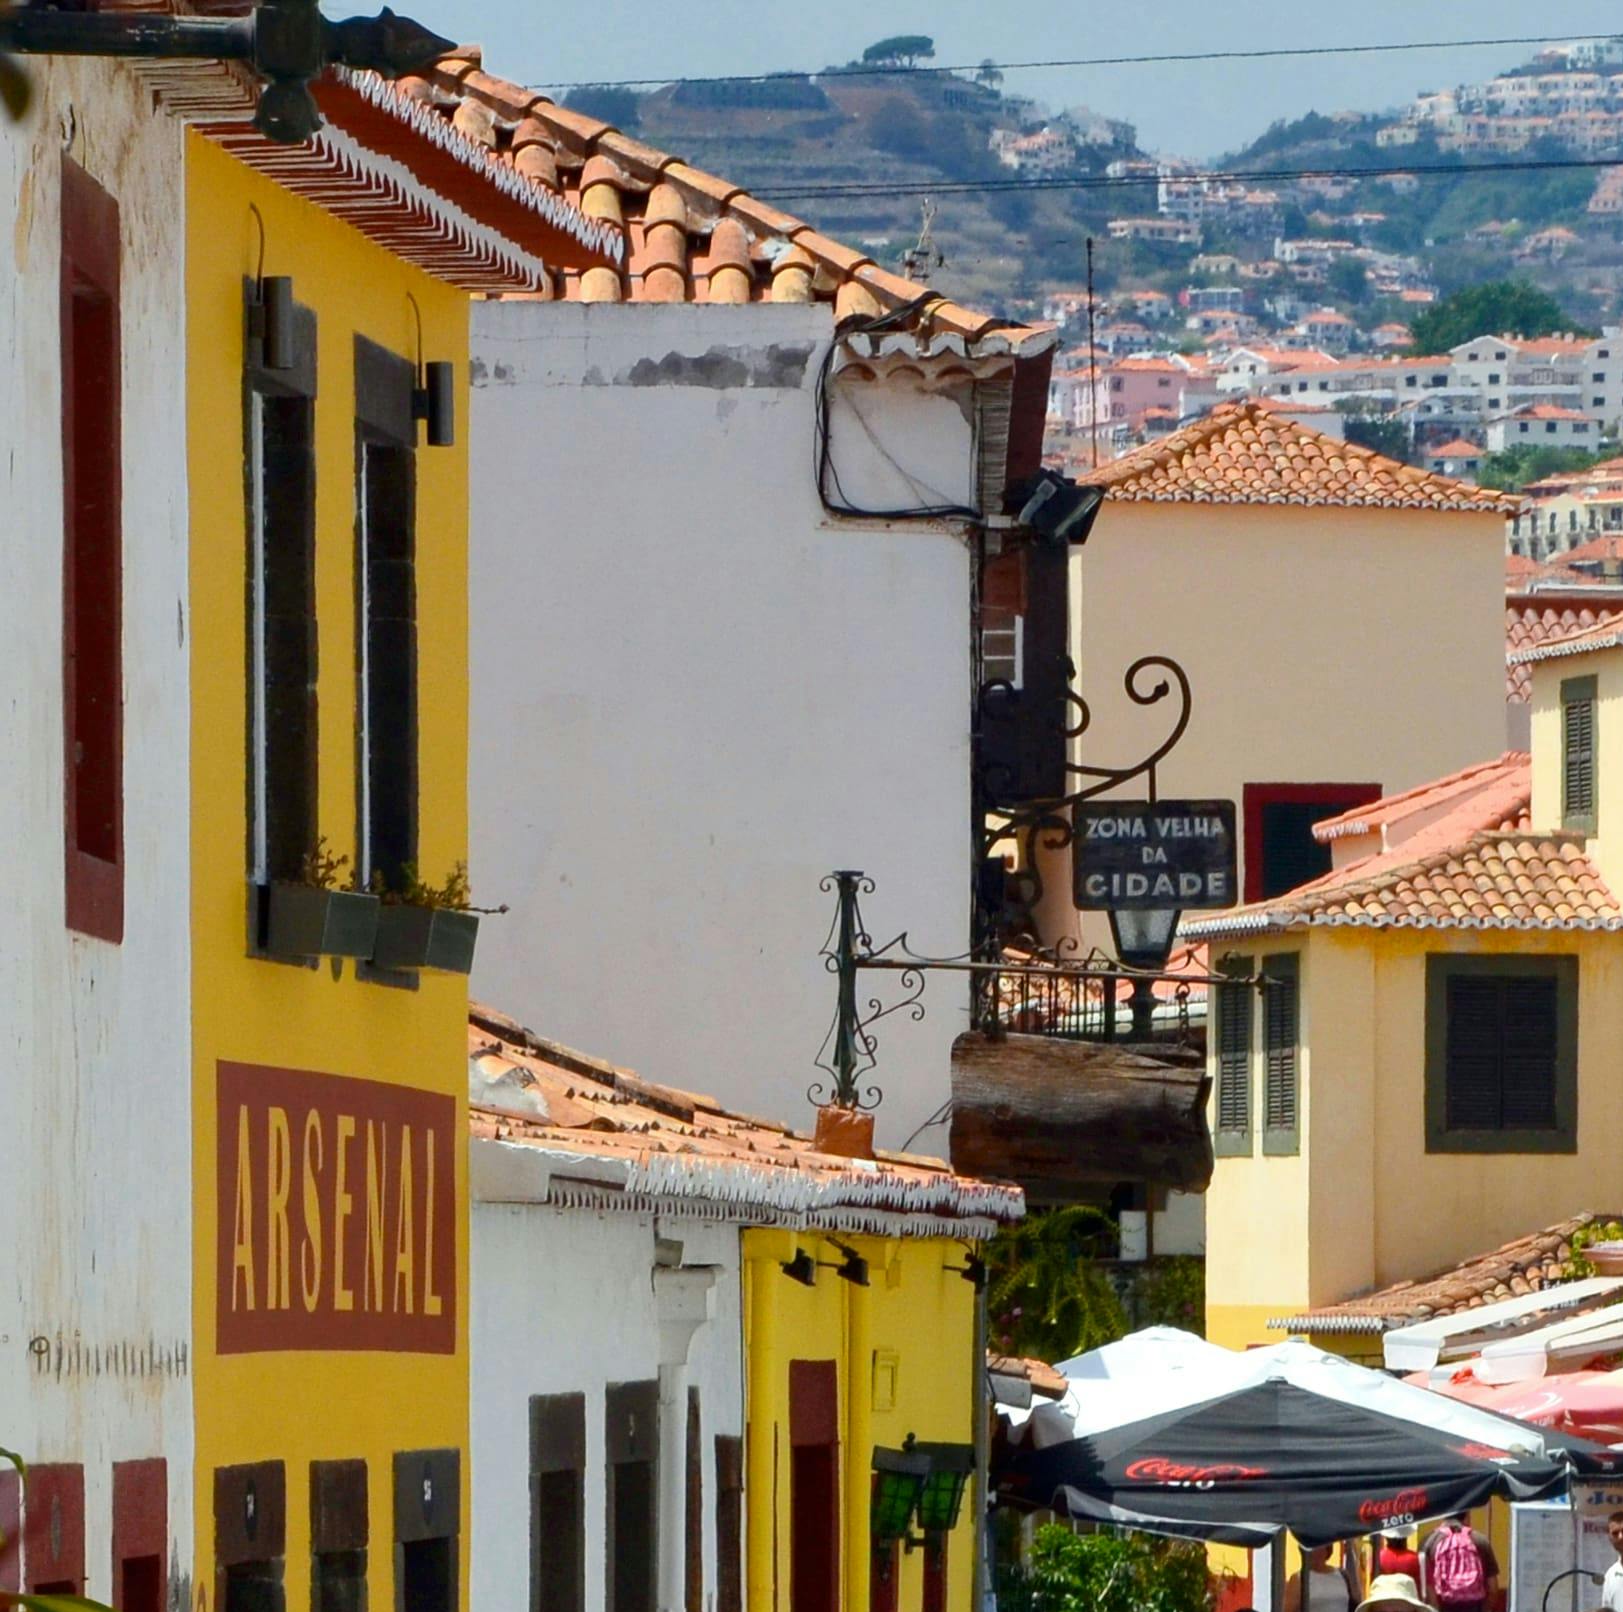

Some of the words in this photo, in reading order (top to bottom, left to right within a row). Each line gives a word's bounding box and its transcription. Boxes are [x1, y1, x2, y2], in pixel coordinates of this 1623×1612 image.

[1085, 816, 1147, 839] ZONA
[1155, 816, 1225, 839] VELHA
[1141, 846, 1167, 865] DA
[1084, 872, 1228, 898] CIDADE
[231, 1103, 443, 1317] ARSENAL
[1358, 1487, 1429, 1523] Coca-Cola
[1381, 1511, 1415, 1528] zero
